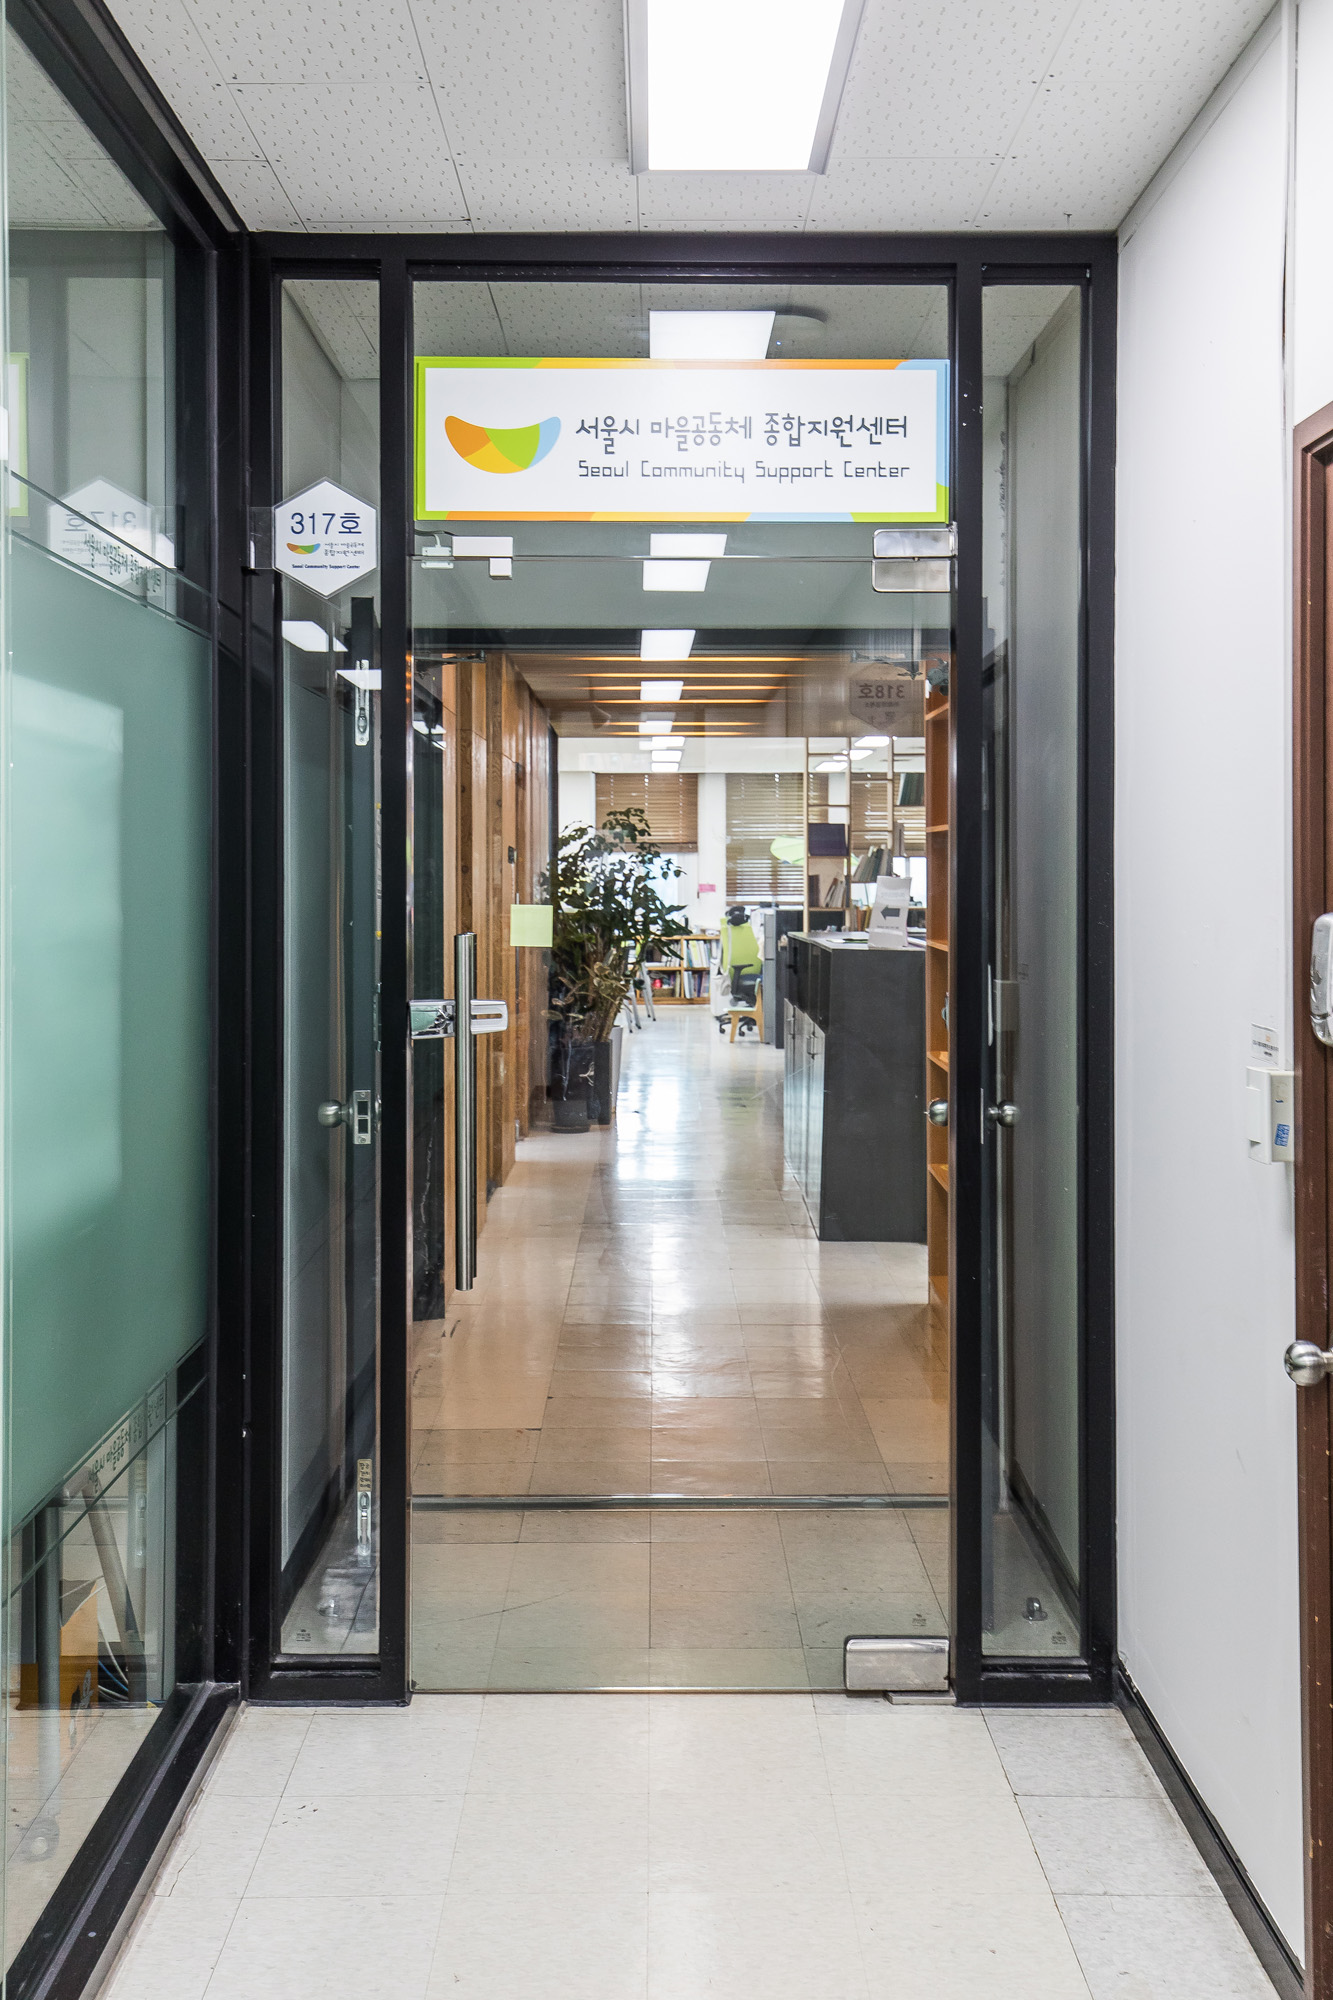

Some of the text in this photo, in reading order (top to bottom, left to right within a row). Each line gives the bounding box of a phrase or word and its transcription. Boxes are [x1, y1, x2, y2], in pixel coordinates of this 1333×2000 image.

[575, 412, 908, 455] 서울시 마을공동체 종합지원센터
[578, 459, 911, 484] Seoul Community Support Center
[291, 511, 362, 535] 317호
